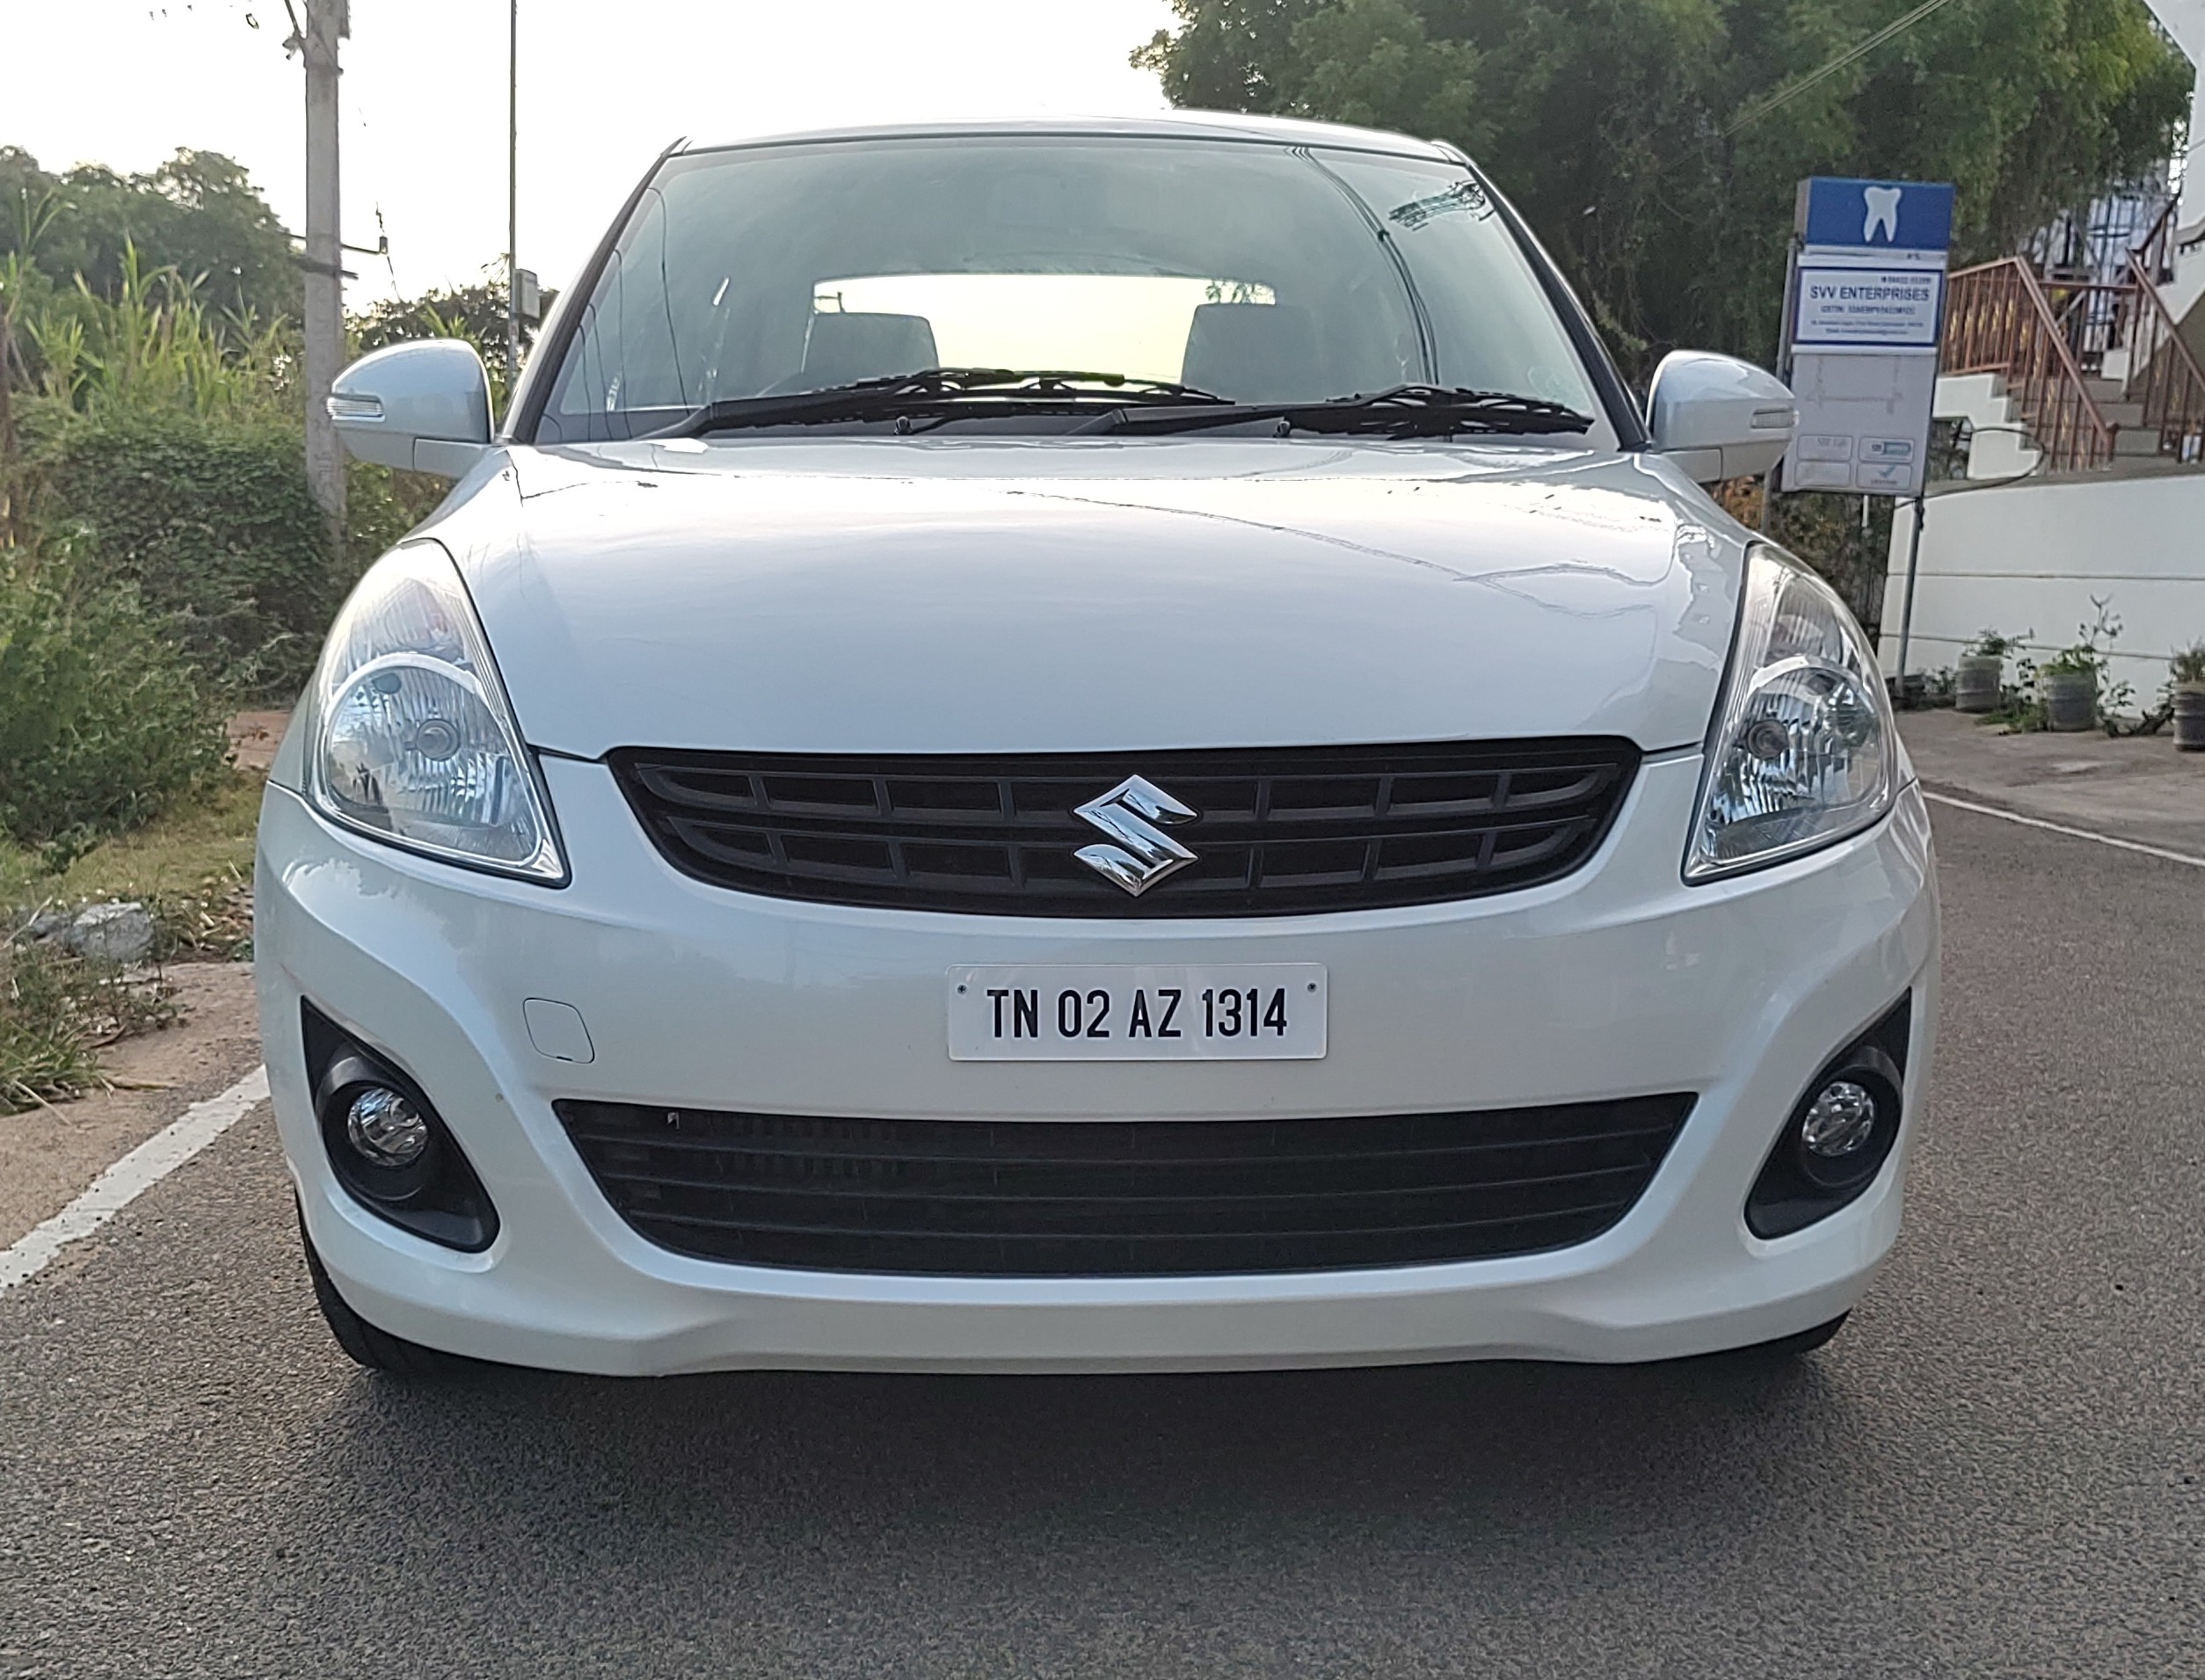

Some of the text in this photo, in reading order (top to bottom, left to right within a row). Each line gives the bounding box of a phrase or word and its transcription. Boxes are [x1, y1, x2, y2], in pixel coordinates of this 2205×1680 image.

[1809, 286, 1930, 302] SVV ENTERPRISES
[986, 987, 1289, 1038] TN 02 AZ 1314
